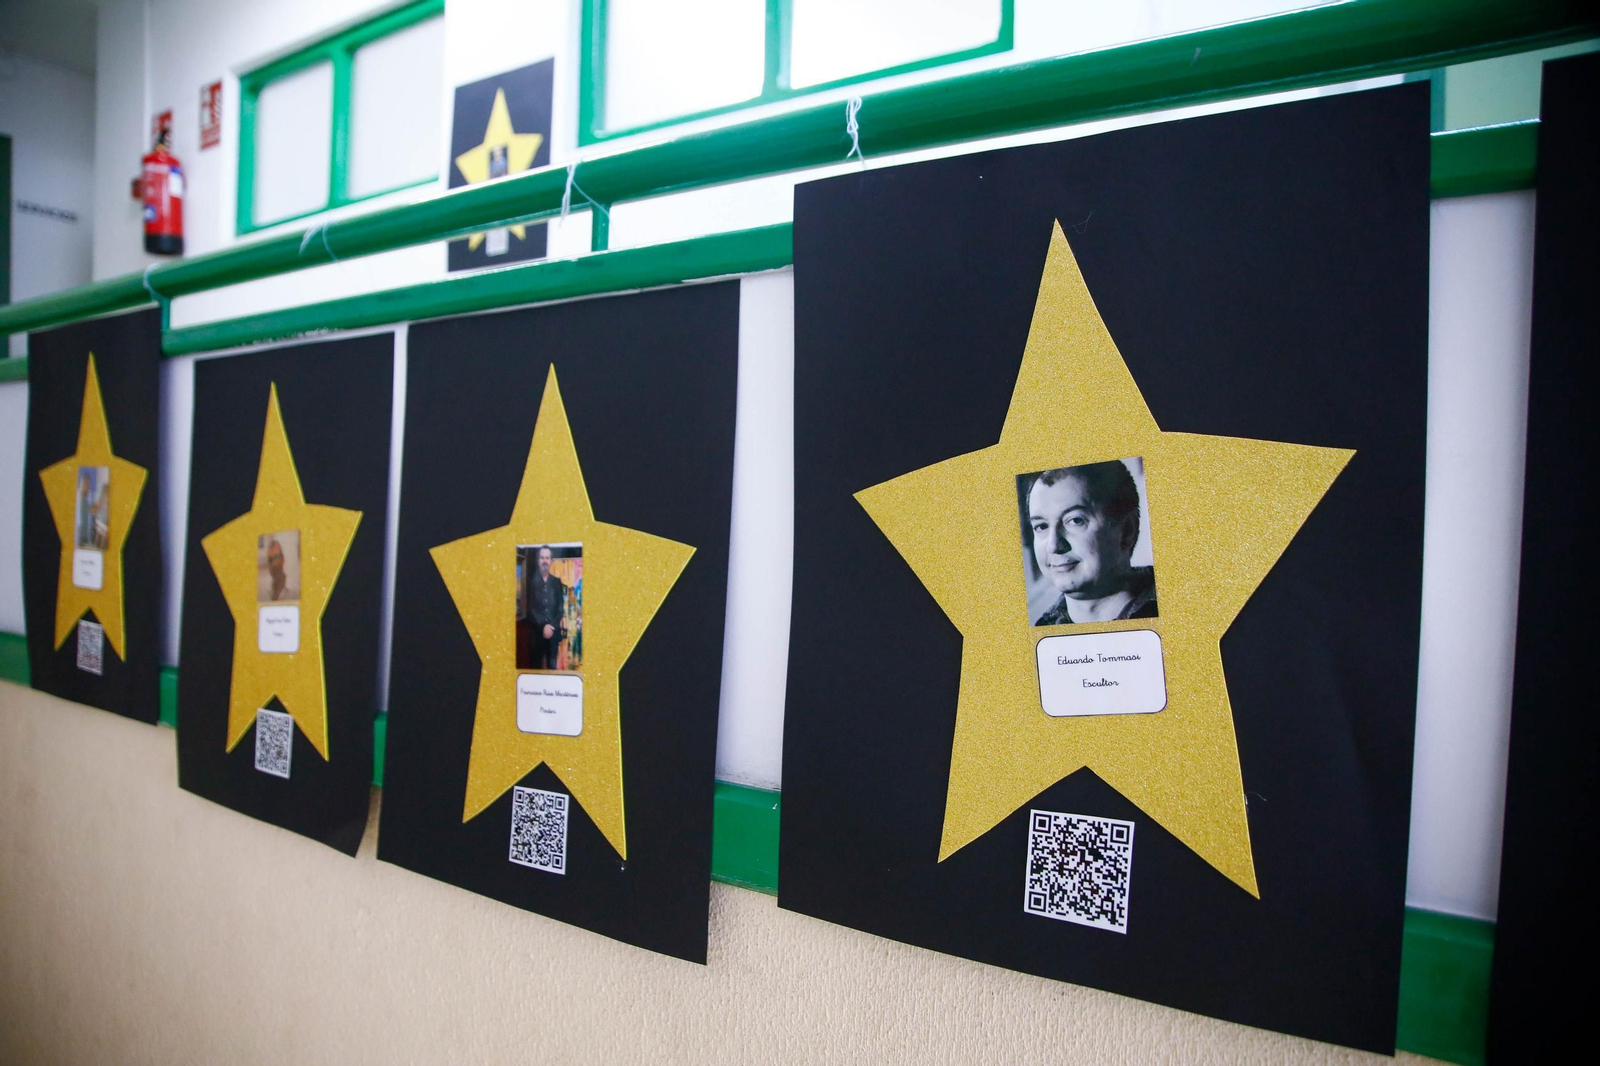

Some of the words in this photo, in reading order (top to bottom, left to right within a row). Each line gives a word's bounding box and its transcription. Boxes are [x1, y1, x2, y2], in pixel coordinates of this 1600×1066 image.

[1057, 655, 1094, 665] Eduardo
[1097, 653, 1141, 662] Tommasi
[1082, 678, 1119, 688] Escultor
